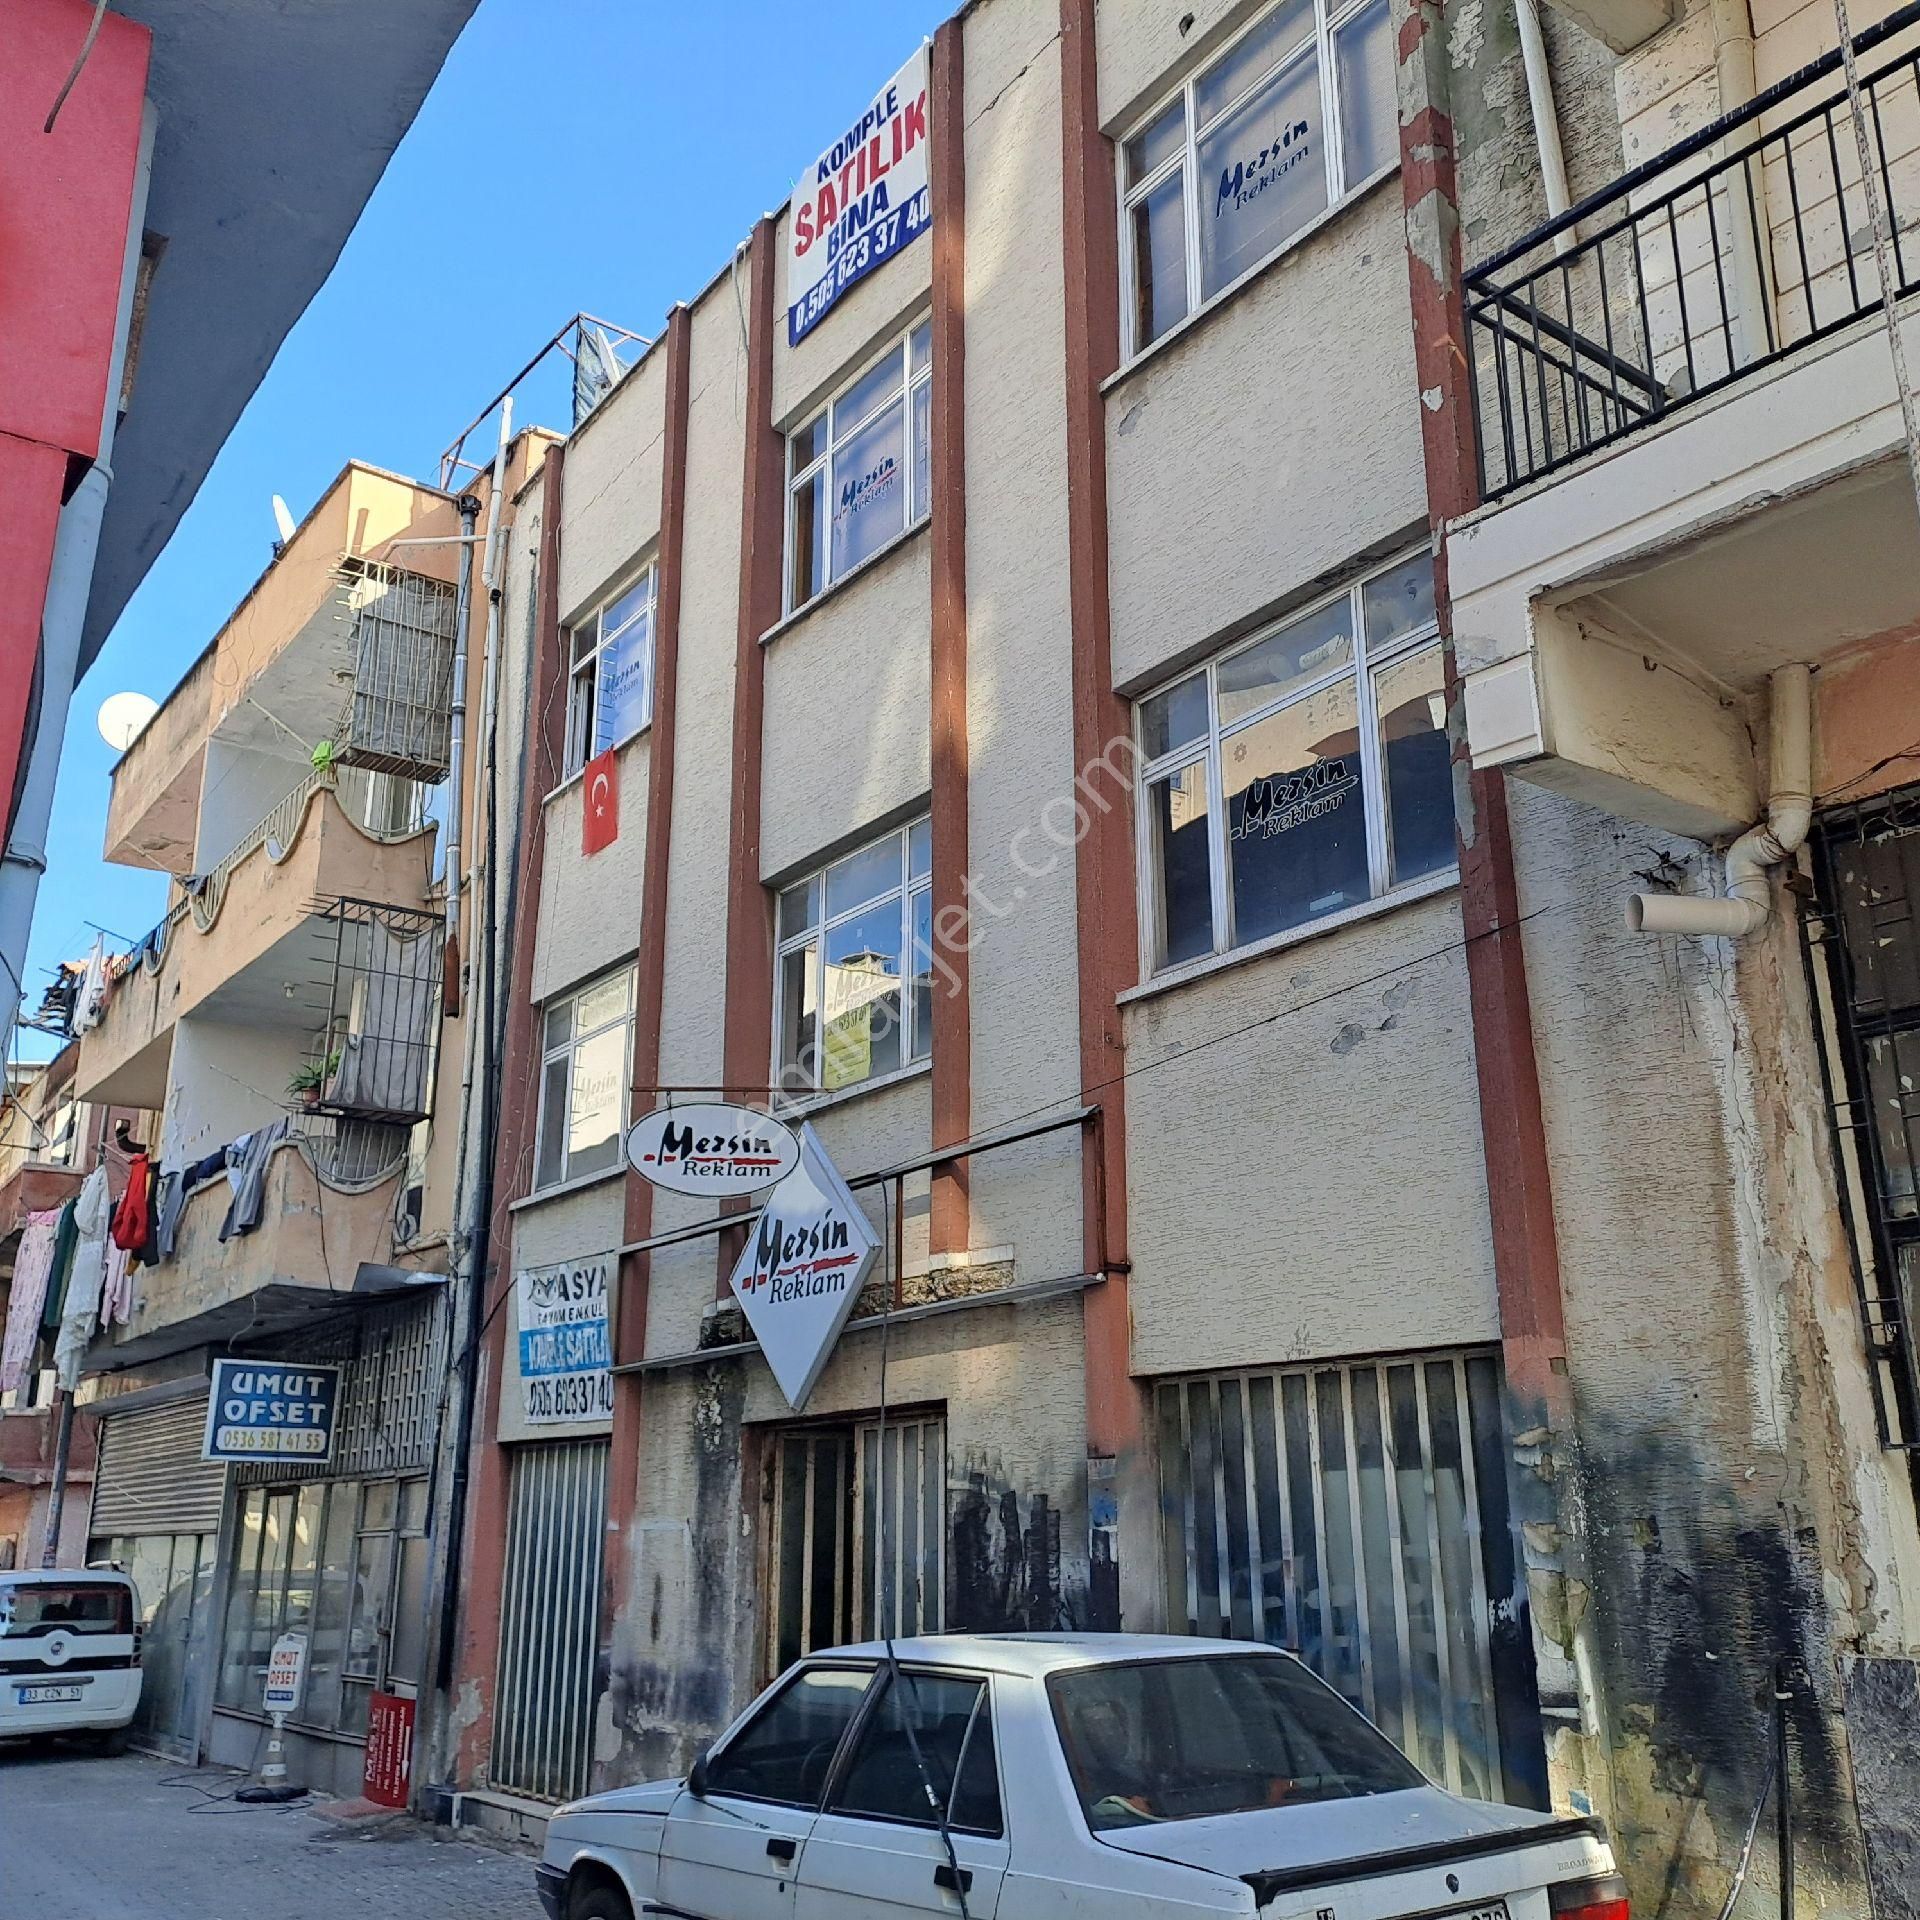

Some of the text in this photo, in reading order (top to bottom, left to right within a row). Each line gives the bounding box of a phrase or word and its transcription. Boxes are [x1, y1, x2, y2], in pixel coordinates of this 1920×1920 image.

[817, 84, 898, 184] KOMPLE
[794, 89, 926, 258] SATILIK
[1215, 119, 1309, 220] Mersin
[1234, 144, 1309, 211] Reklam
[827, 179, 890, 267] BİNA
[794, 187, 930, 334] 0.505 623 37 40
[838, 456, 894, 520] Mersin
[1239, 757, 1347, 840] Mersin
[1261, 792, 1347, 840] Reklam
[657, 1120, 772, 1166] Mersin
[681, 1160, 771, 1177] Reklam
[558, 1263, 607, 1302] ASYA
[750, 1207, 849, 1295] Mersin
[768, 1270, 845, 1304] Reklam
[223, 1399, 327, 1425] OFSET
[231, 1372, 326, 1397] UMUT
[223, 1430, 256, 1448] 0536
[305, 1433, 321, 1450] 55
